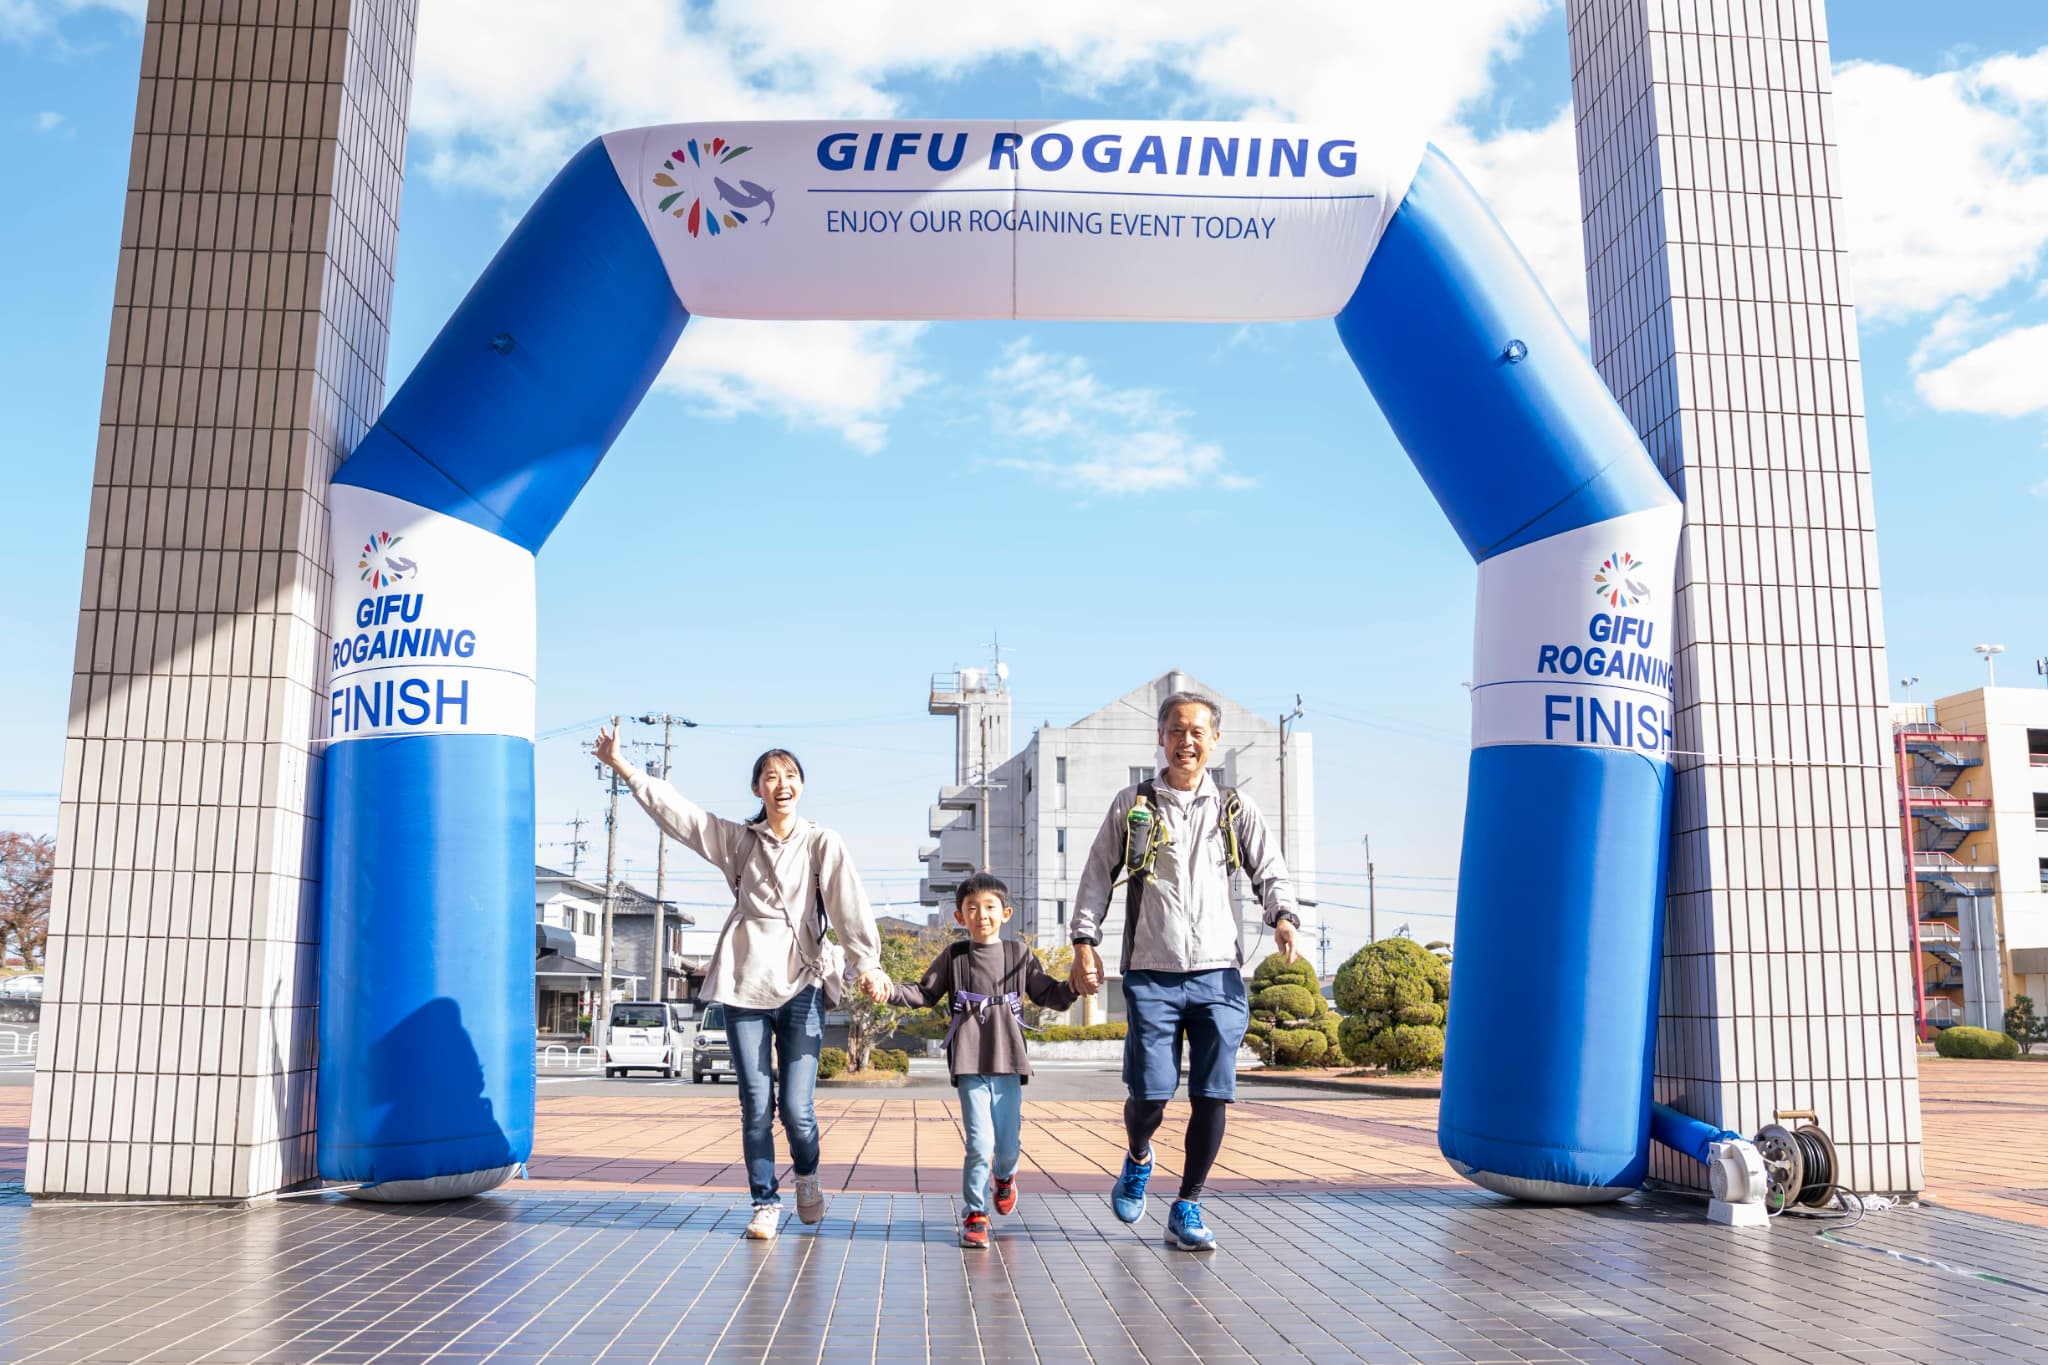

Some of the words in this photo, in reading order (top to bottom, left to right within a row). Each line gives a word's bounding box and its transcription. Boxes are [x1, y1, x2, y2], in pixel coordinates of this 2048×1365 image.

[816, 132, 969, 172] GIFU
[988, 132, 1358, 178] ROGAINING
[826, 210, 903, 233] ENJOY
[909, 210, 962, 233] OUR
[969, 209, 1103, 235] ROGAINING
[1110, 213, 1186, 238] EVENT
[1191, 216, 1276, 240] TODAY
[356, 593, 424, 629] GIFU
[1588, 612, 1654, 650] GIFU
[331, 628, 476, 673] ROGAINING
[1537, 644, 1674, 694] ROGAINING
[330, 678, 469, 738] FINISH
[1545, 694, 1674, 759] FINISH
